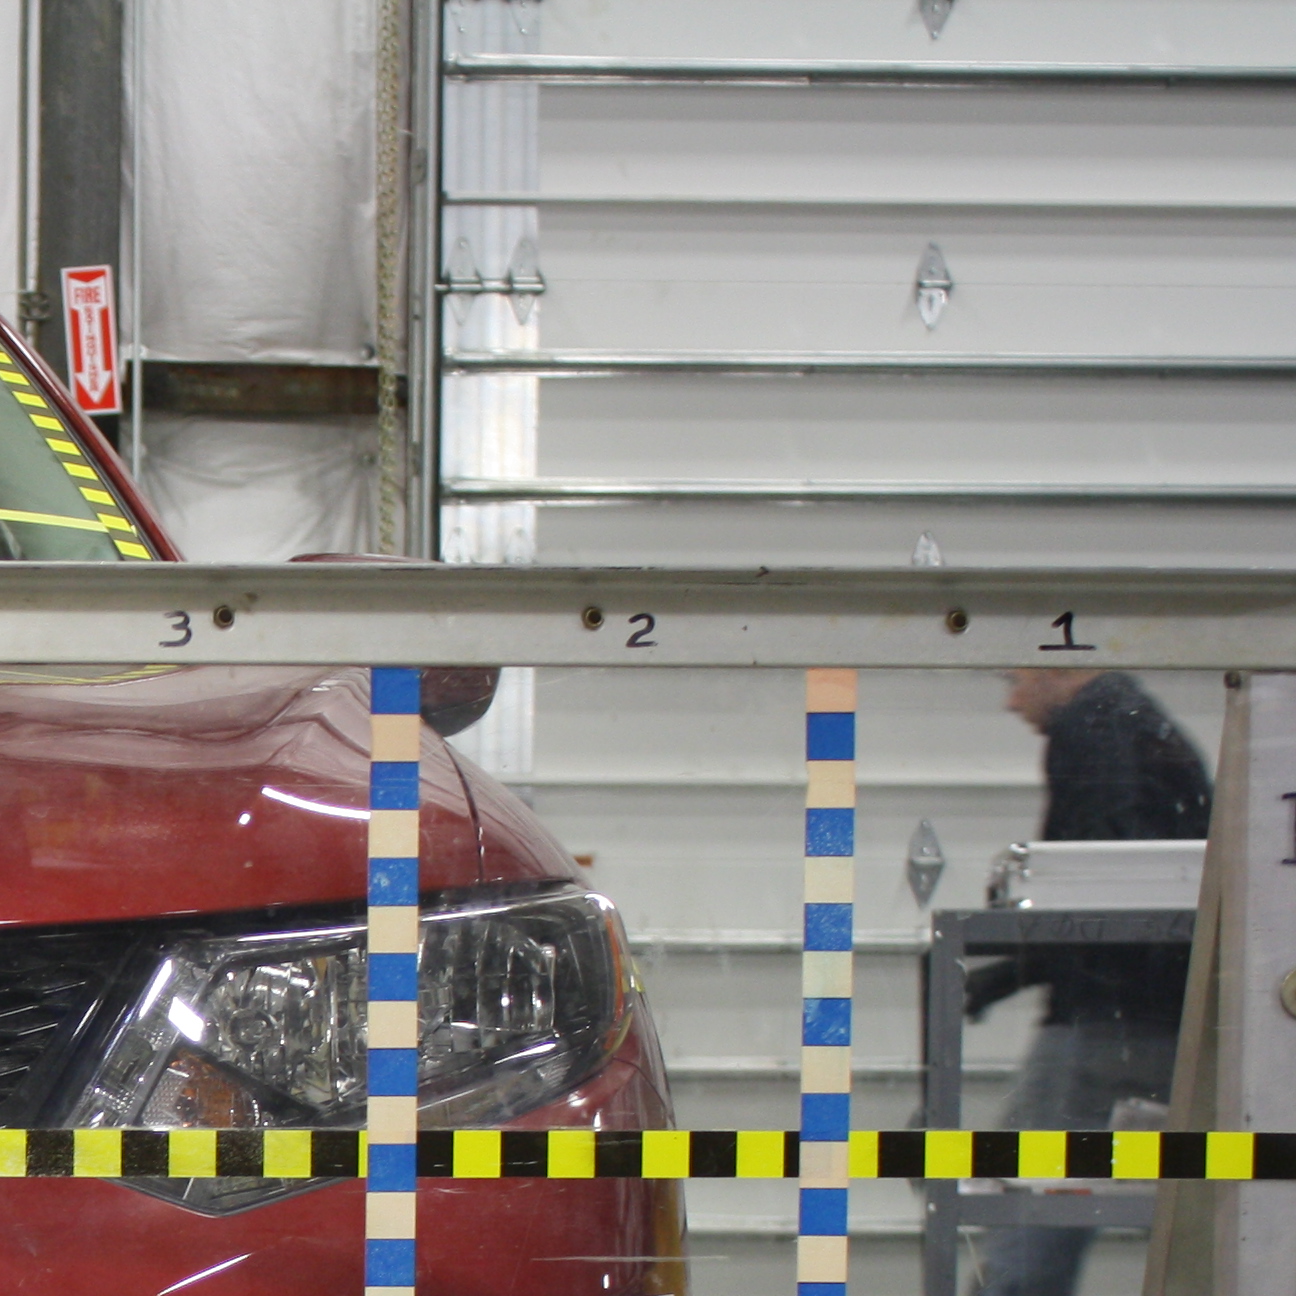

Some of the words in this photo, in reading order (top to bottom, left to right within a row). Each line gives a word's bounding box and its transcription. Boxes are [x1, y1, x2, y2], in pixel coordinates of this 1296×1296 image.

[73, 287, 101, 304] FIRE
[158, 610, 192, 648] 3
[625, 612, 660, 647] 2
[1038, 610, 1097, 651] 1
